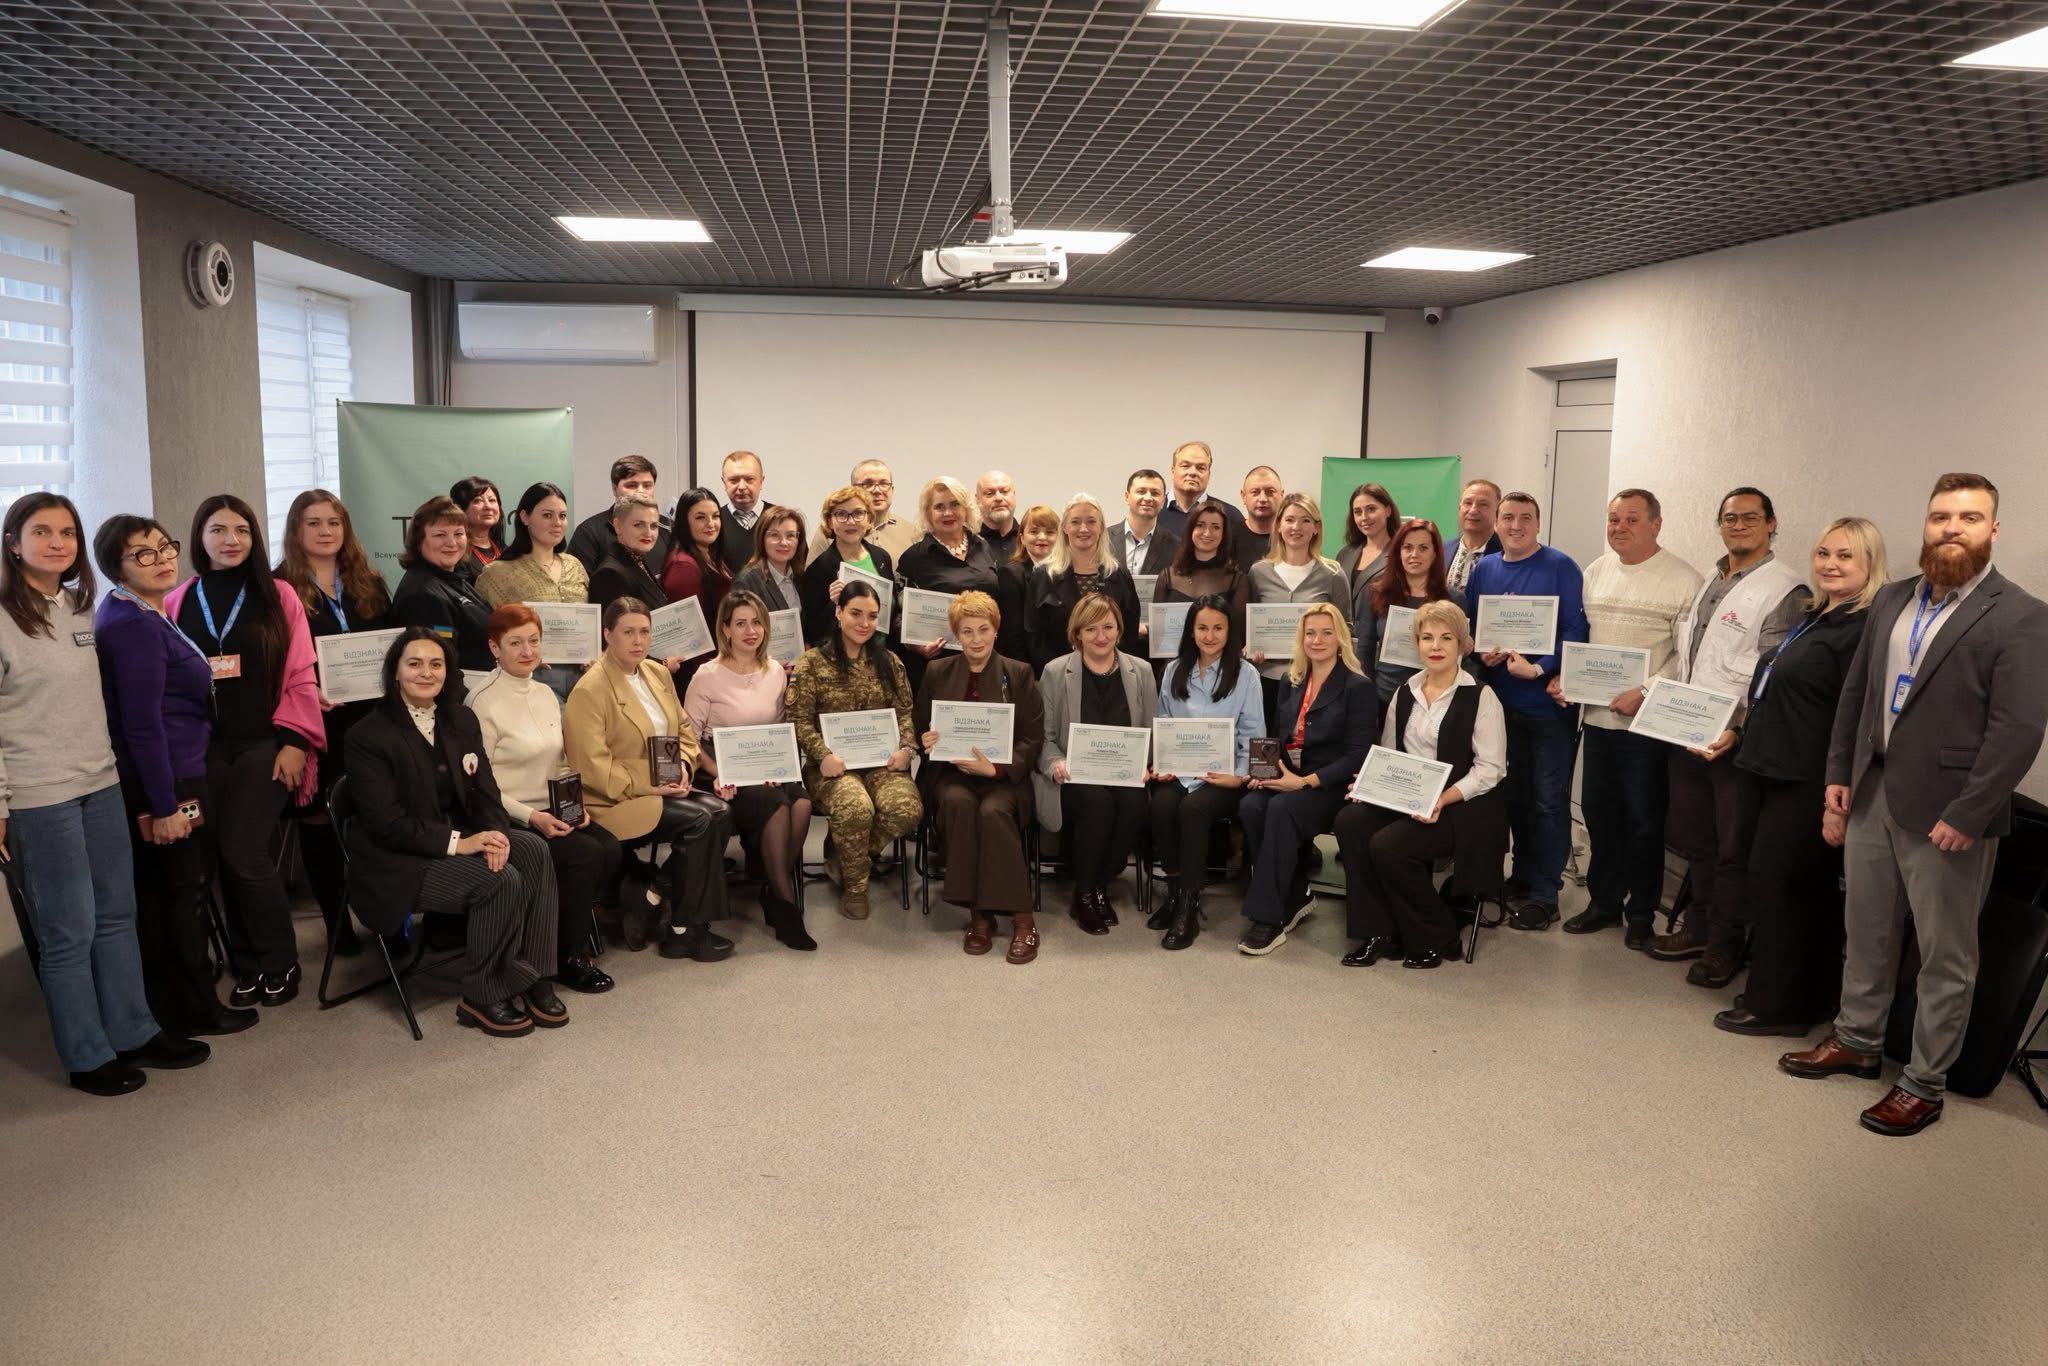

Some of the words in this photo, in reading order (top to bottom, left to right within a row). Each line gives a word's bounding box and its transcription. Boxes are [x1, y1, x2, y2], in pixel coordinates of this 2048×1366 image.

[1585, 659, 1624, 670] ВІДЗНАКА
[1670, 697, 1707, 712] ВІДЗНАКА
[953, 717, 991, 726] ВІДЗНАКА
[1090, 740, 1126, 749] ВІДЗНАКА
